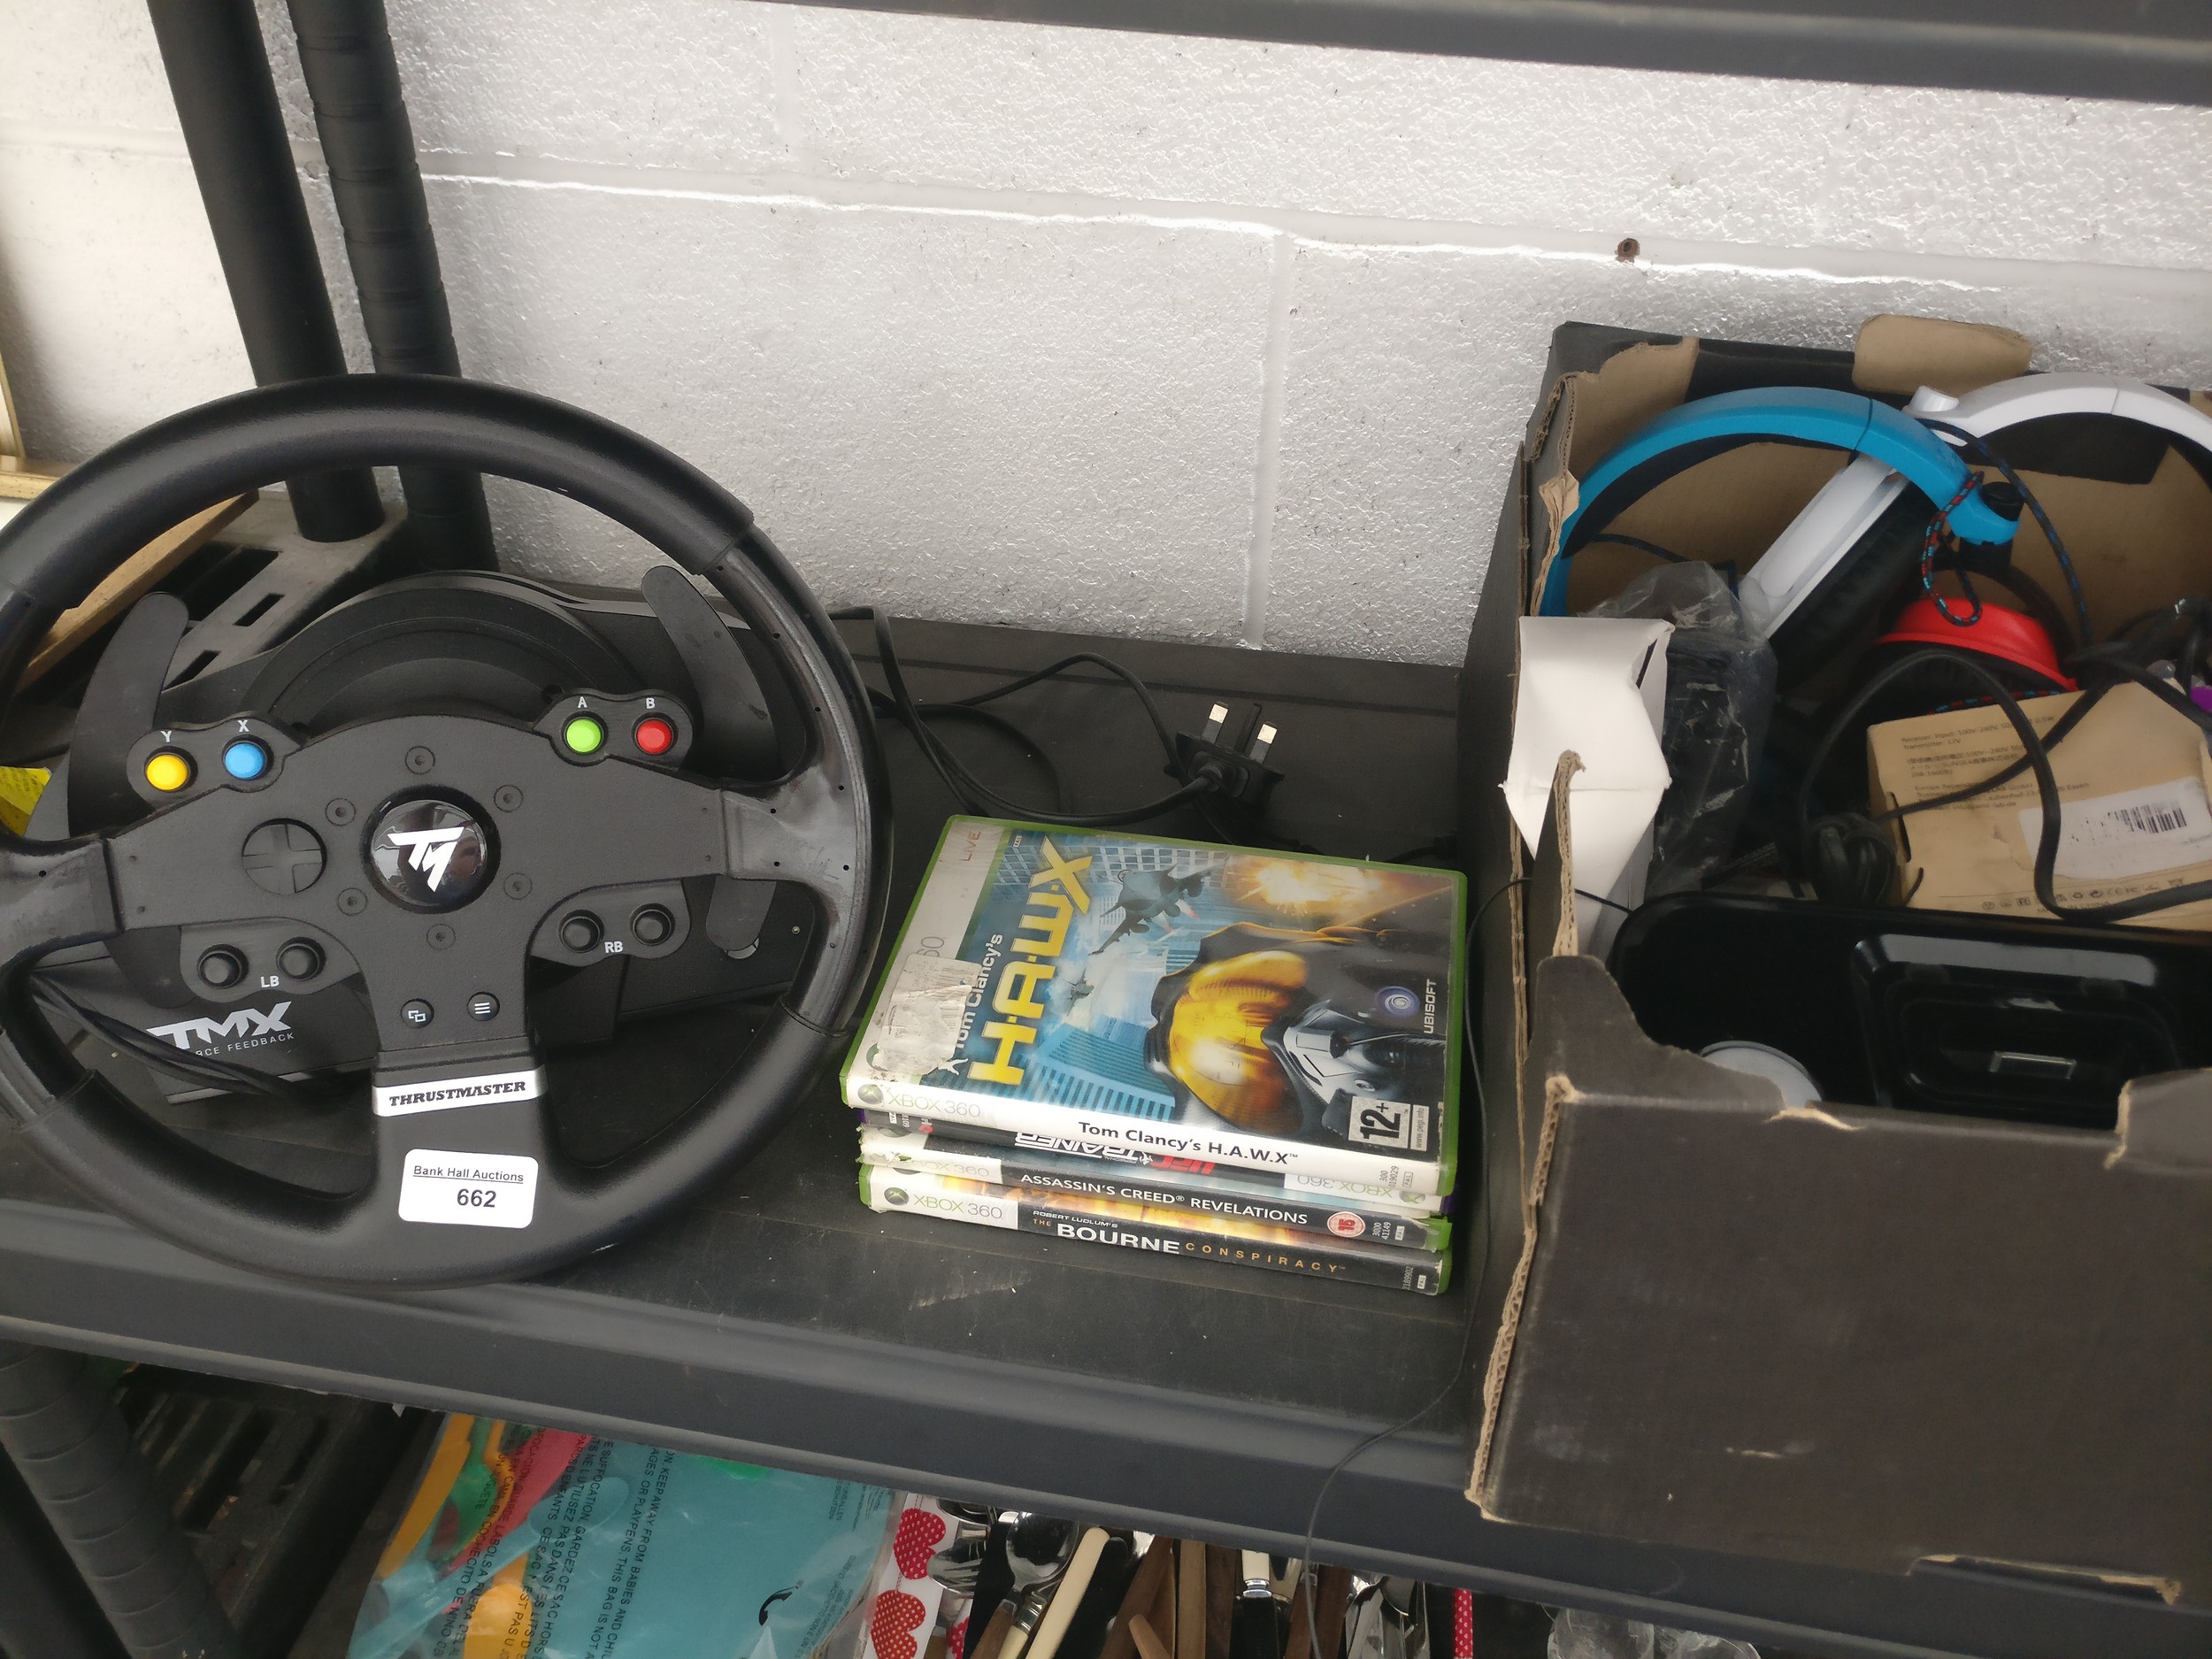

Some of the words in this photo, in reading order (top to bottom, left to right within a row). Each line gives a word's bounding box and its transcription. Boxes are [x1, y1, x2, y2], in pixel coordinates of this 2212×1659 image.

[577, 695, 588, 709] A
[646, 697, 656, 710] B
[160, 730, 173, 743] Y
[237, 719, 250, 733] X
[959, 830, 981, 862] LIVE
[604, 941, 624, 954] RB
[260, 975, 280, 988] LB
[1424, 979, 1437, 1034] UBISOFT
[146, 1001, 292, 1050] TMX
[227, 1032, 295, 1052] FEEDBACK
[389, 1081, 526, 1107] THRUSTMASTER
[887, 1092, 941, 1112] XBOX
[944, 1100, 981, 1118] 360
[1078, 1121, 1118, 1138] Tom
[1125, 1129, 1202, 1153] Clancy's
[413, 1165, 443, 1177] Bank
[447, 1167, 469, 1179] Hall
[472, 1170, 524, 1182] Auctions
[457, 1188, 497, 1208] 662
[953, 1164, 990, 1178] 360
[1020, 1174, 1116, 1195] ASSASSIN'S
[1191, 1197, 1309, 1225] REVELATIONS
[1339, 1181, 1394, 1199] XBOX
[913, 1194, 964, 1213] XBOX
[968, 1202, 1003, 1219] 360
[1033, 1210, 1070, 1221] ROBERT
[1071, 1217, 1118, 1228] LUDLUM'S
[1033, 1218, 1052, 1227] THE
[1057, 1223, 1180, 1255] BOURNE
[638, 1479, 650, 1496] OR
[654, 1467, 670, 1495] KEEP
[645, 1495, 662, 1526] AWAY
[539, 1526, 553, 1544] CE
[554, 1525, 569, 1548] PAS
[634, 1528, 652, 1563] FROM
[530, 1546, 547, 1571] SAC
[562, 1525, 586, 1574] GARDEZ
[542, 1549, 563, 1584] DANS
[611, 1556, 627, 1583] THIS
[452, 1586, 466, 1604] DE
[556, 1574, 570, 1593] CE
[619, 1566, 641, 1606] BABIES
[546, 1593, 564, 1620] SAC
[602, 1586, 618, 1611] BAG
[507, 1611, 524, 1636] PAS
[596, 1613, 609, 1624] IS
[611, 1608, 626, 1632] AND
[534, 1620, 554, 1655] HORS
[588, 1625, 603, 1650] NOT
